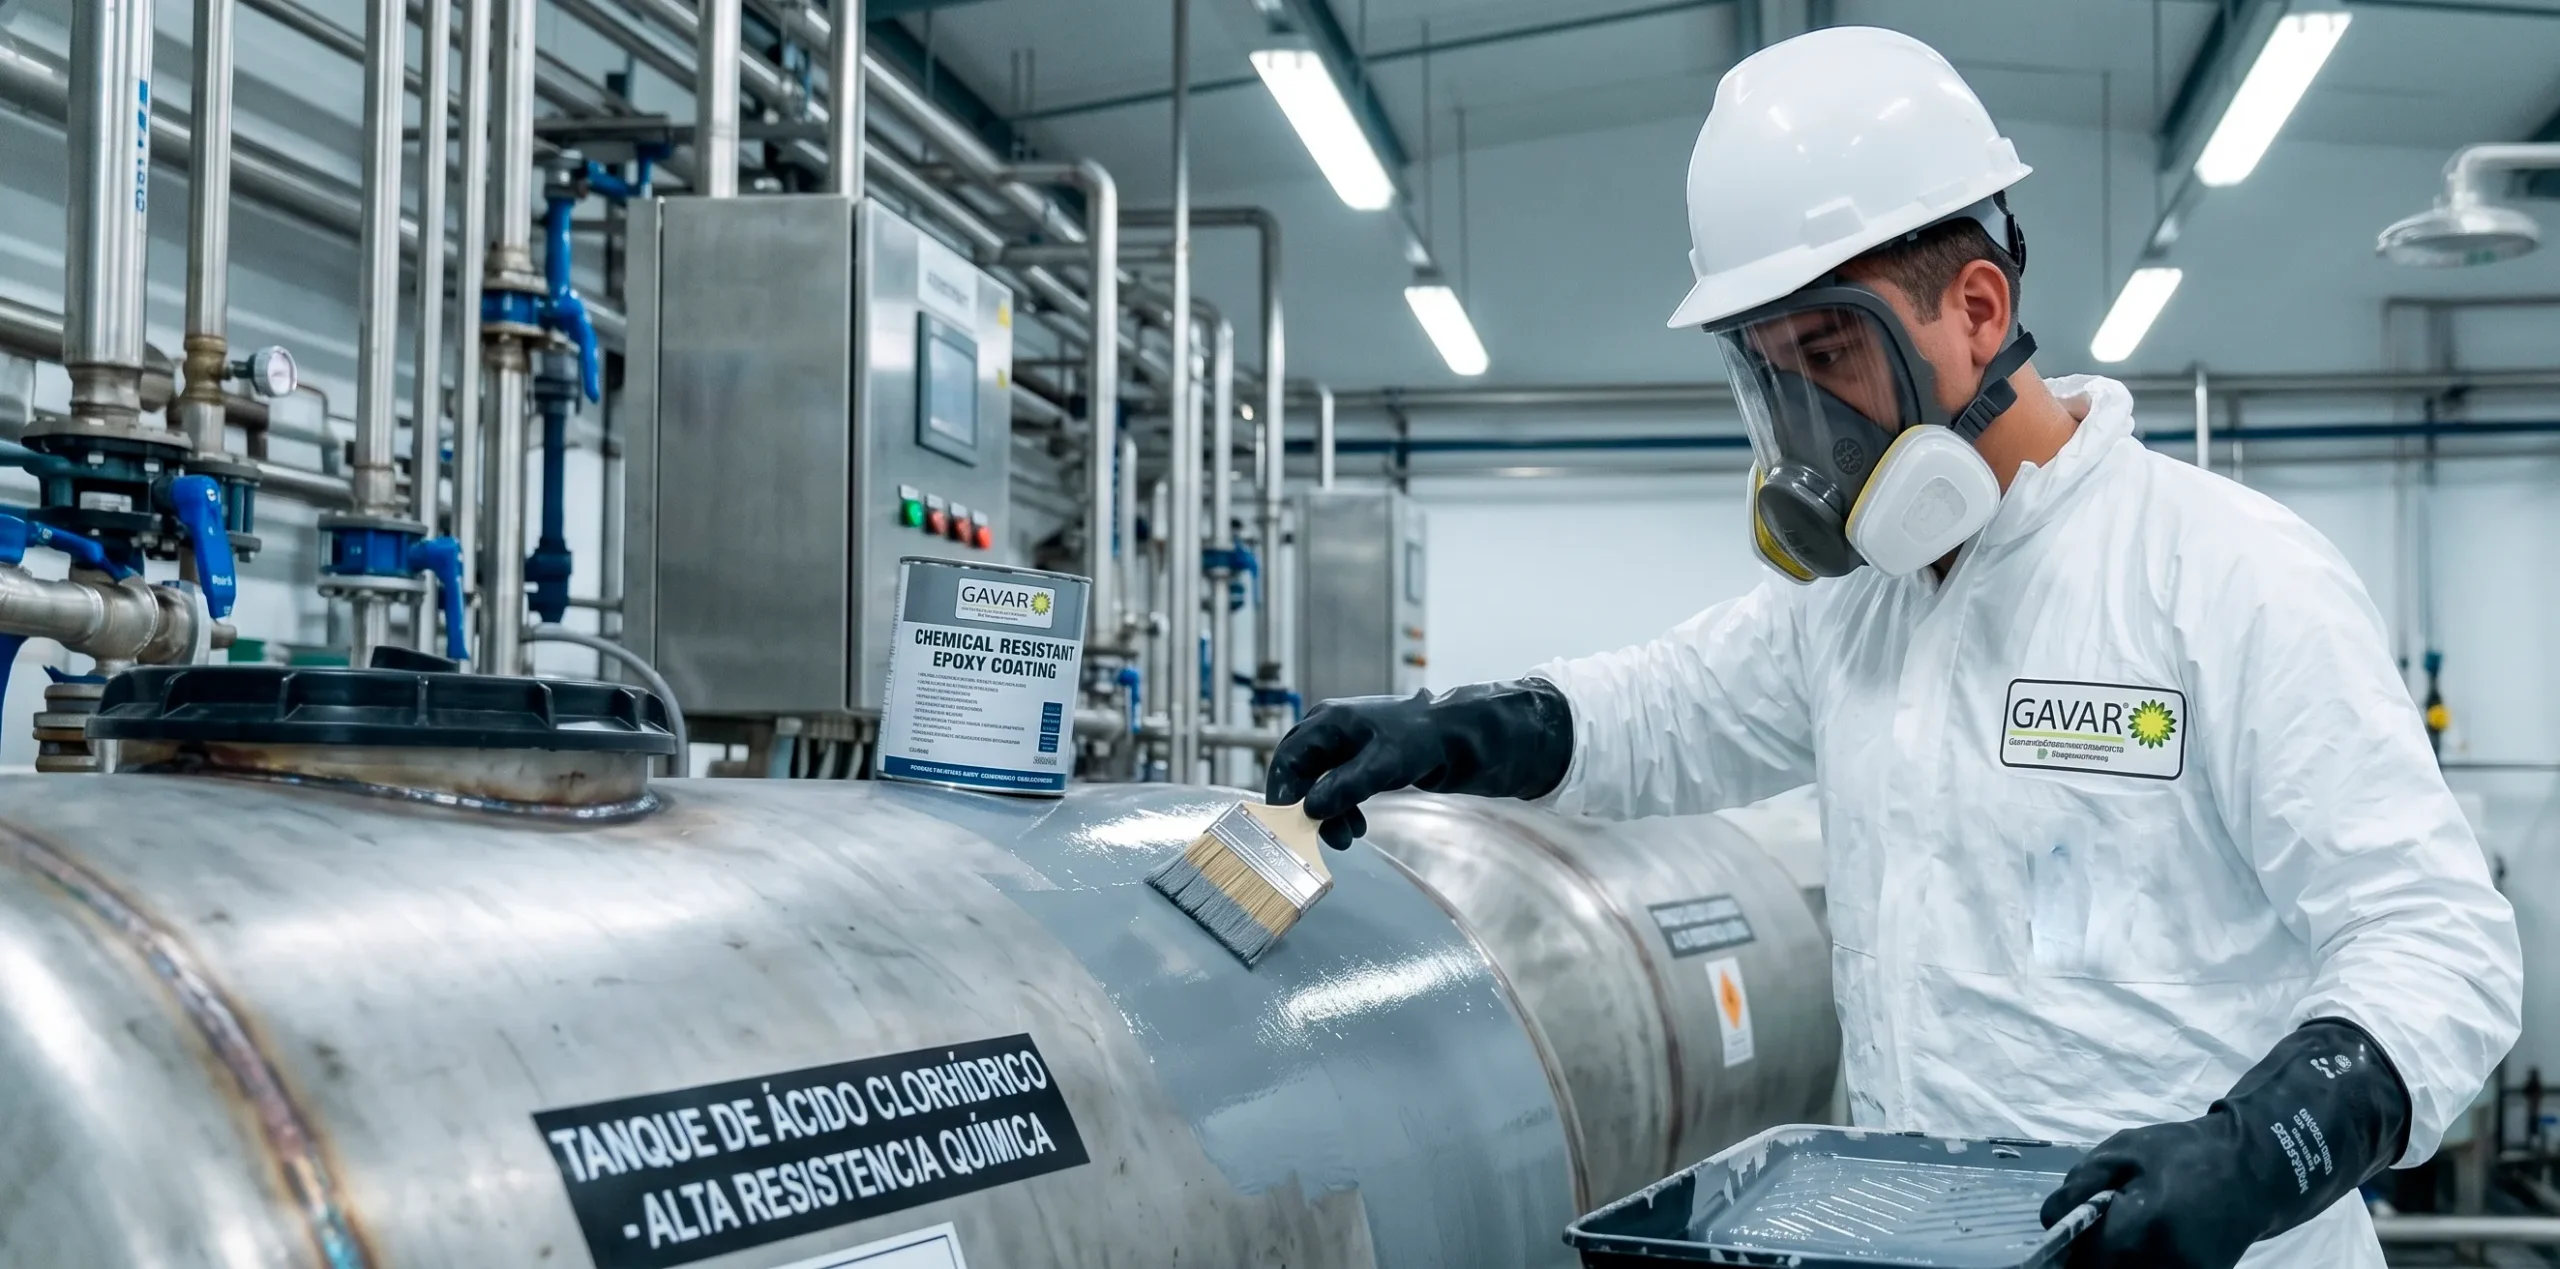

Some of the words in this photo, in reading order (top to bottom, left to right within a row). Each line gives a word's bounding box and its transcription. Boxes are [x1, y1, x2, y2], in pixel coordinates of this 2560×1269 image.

[962, 586, 1029, 609] GAVAR
[915, 628, 994, 652] CHEMICAL
[1000, 638, 1075, 662] RESISTANT
[933, 651, 987, 671] EPOXY
[991, 658, 1057, 679] COATING
[549, 1107, 718, 1182] TANQUE
[707, 1098, 771, 1152] DE
[761, 1081, 868, 1142] ÁCIDO
[865, 1050, 1047, 1120] CLORHÍDRICO
[731, 1135, 946, 1225] RESISTENCIA
[939, 1111, 1057, 1175] QUÍMICA
